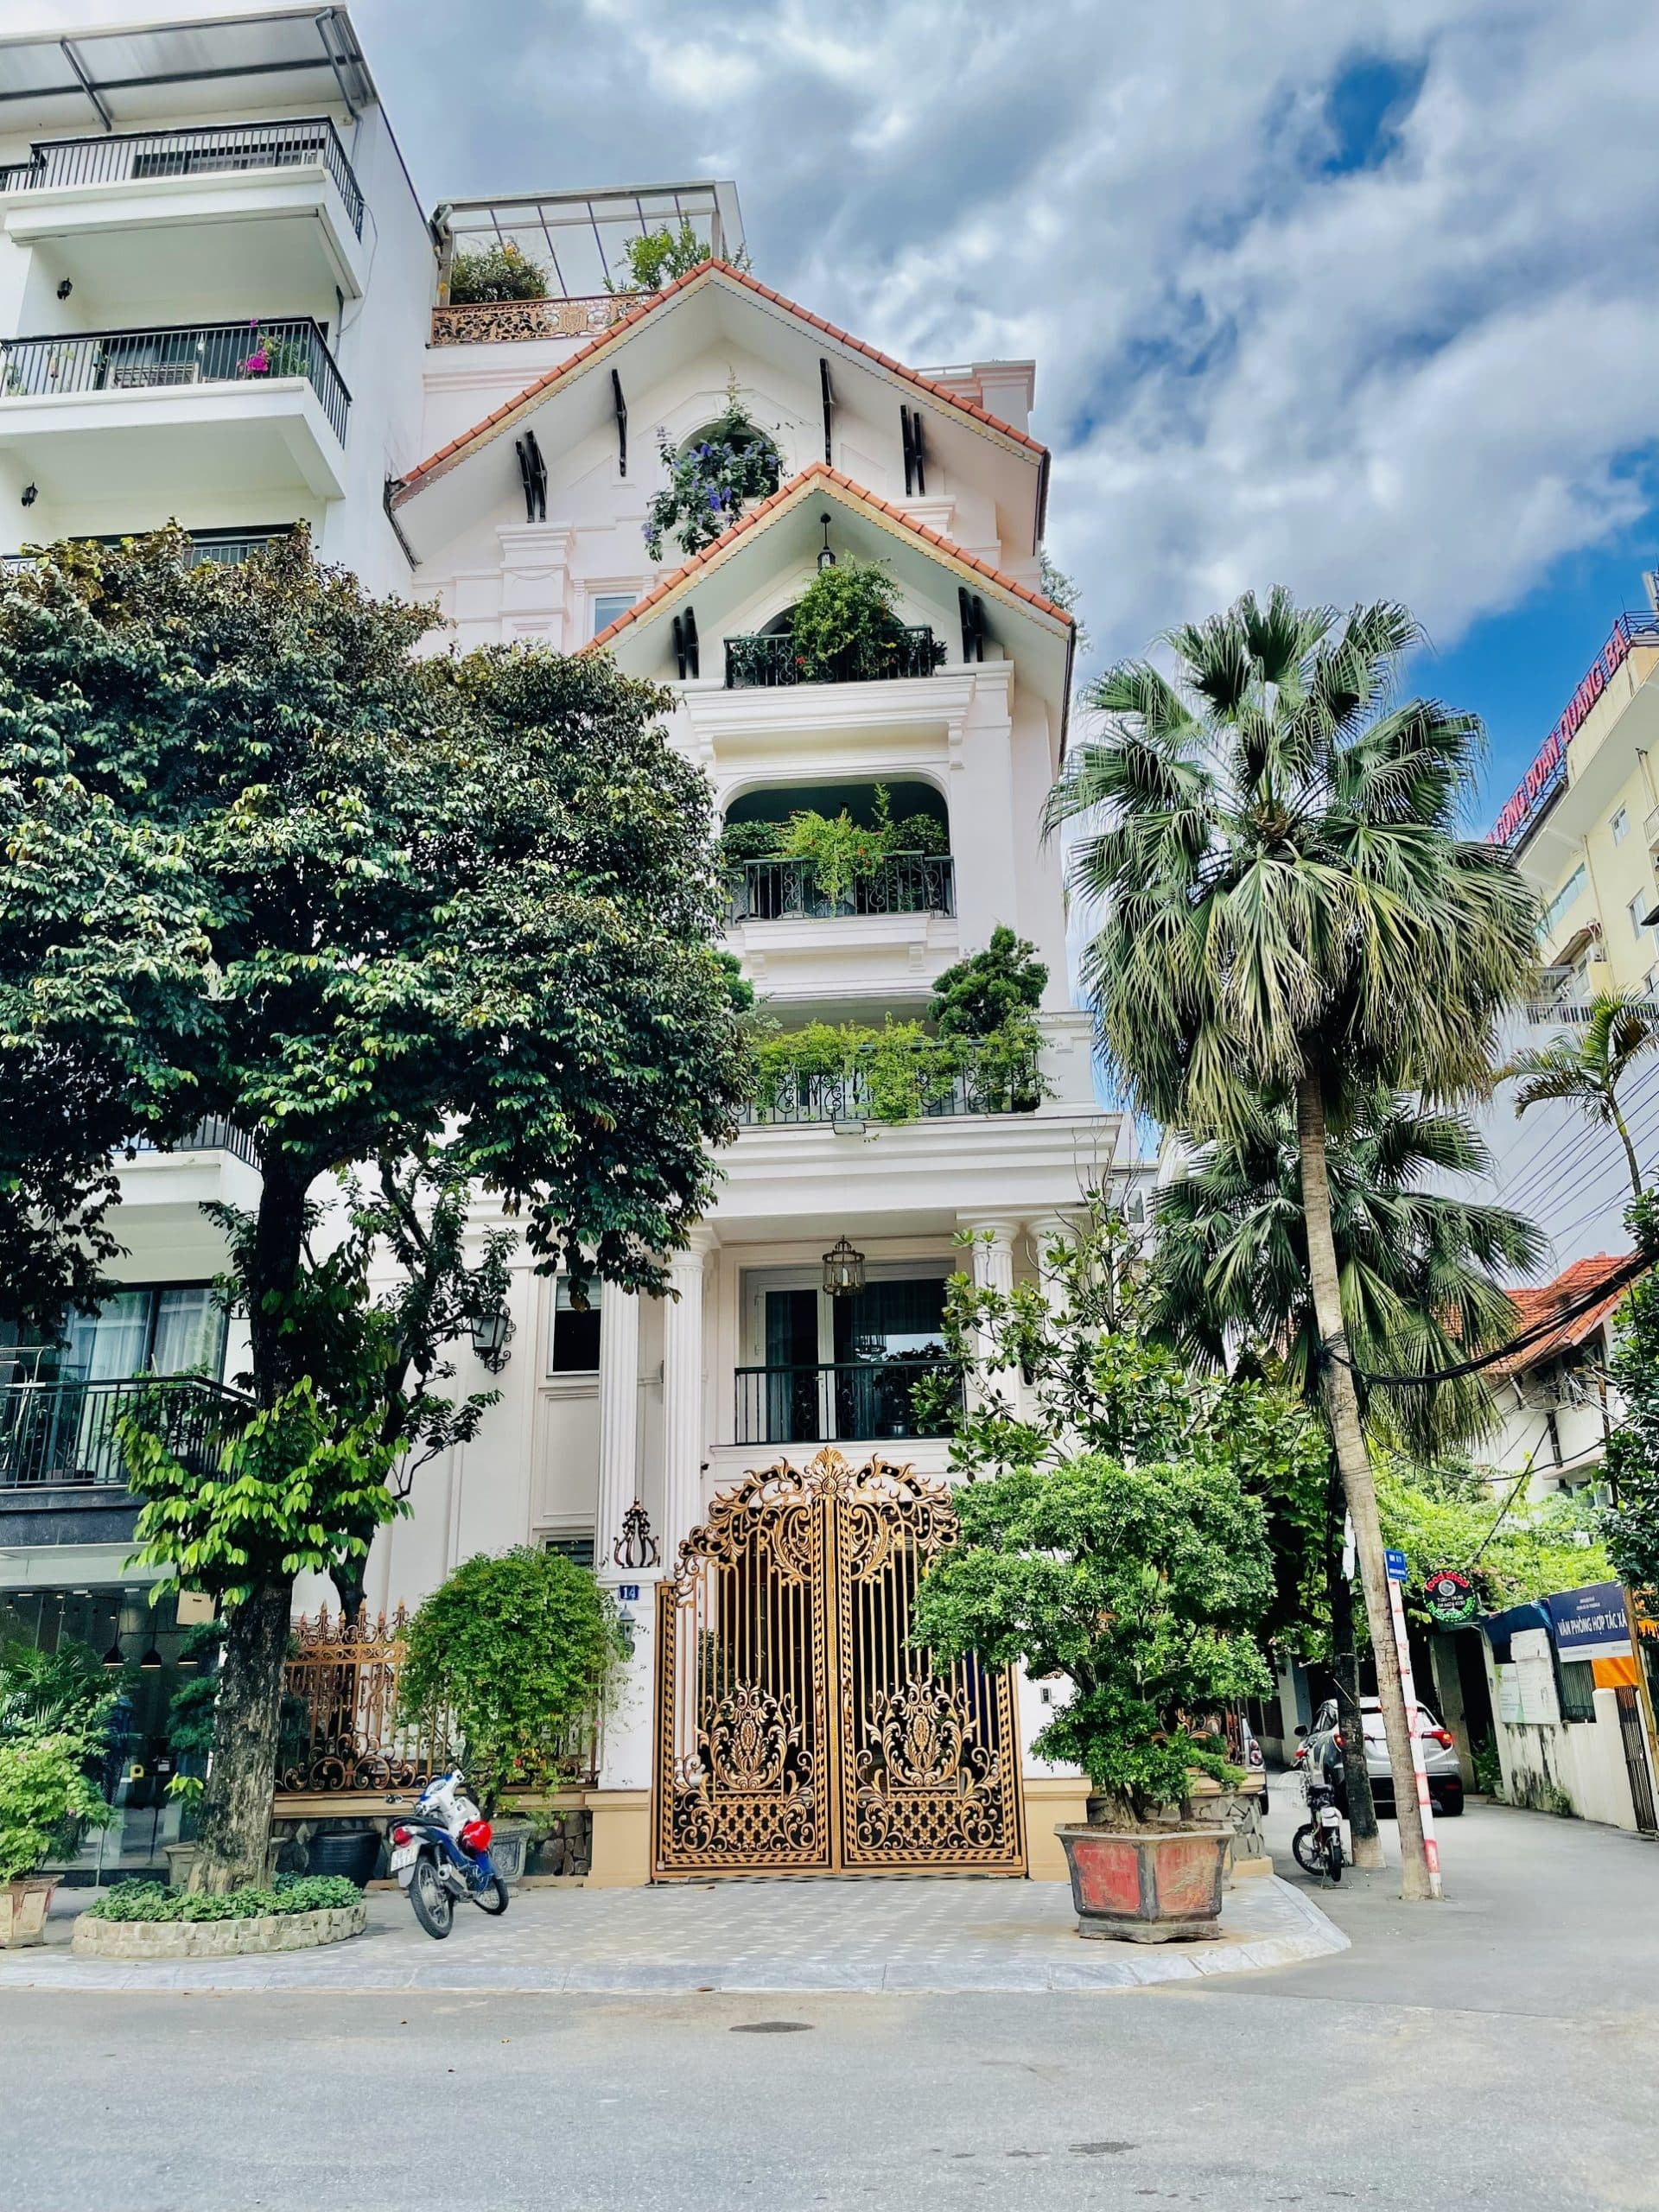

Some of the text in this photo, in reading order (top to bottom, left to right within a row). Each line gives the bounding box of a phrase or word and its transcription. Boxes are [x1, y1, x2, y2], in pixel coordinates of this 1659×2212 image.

[1604, 620, 1628, 676] BÁ
[623, 1586, 636, 1599] 14
[1558, 1618, 1571, 1637] VĂN
[1570, 1615, 1592, 1635] PHÒNG
[1605, 1610, 1618, 1630] TÁC
